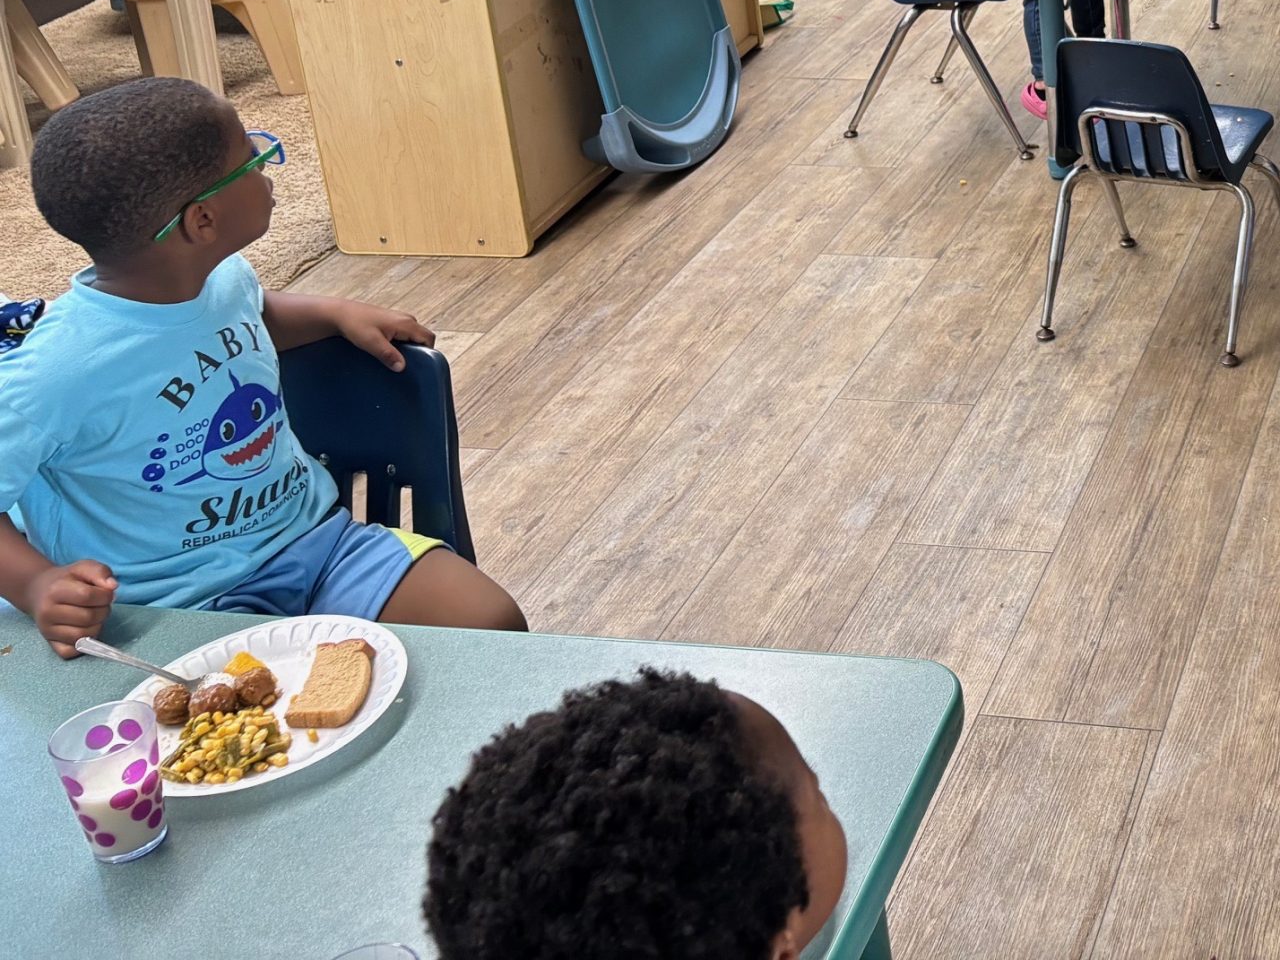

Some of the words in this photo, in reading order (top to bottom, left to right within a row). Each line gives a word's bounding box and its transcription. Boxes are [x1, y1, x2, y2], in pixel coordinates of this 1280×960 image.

[156, 322, 262, 413] BABY
[185, 418, 210, 437] DOO
[175, 434, 205, 453] DOO
[170, 449, 201, 470] DOO
[182, 519, 259, 549] REPUBLICA
